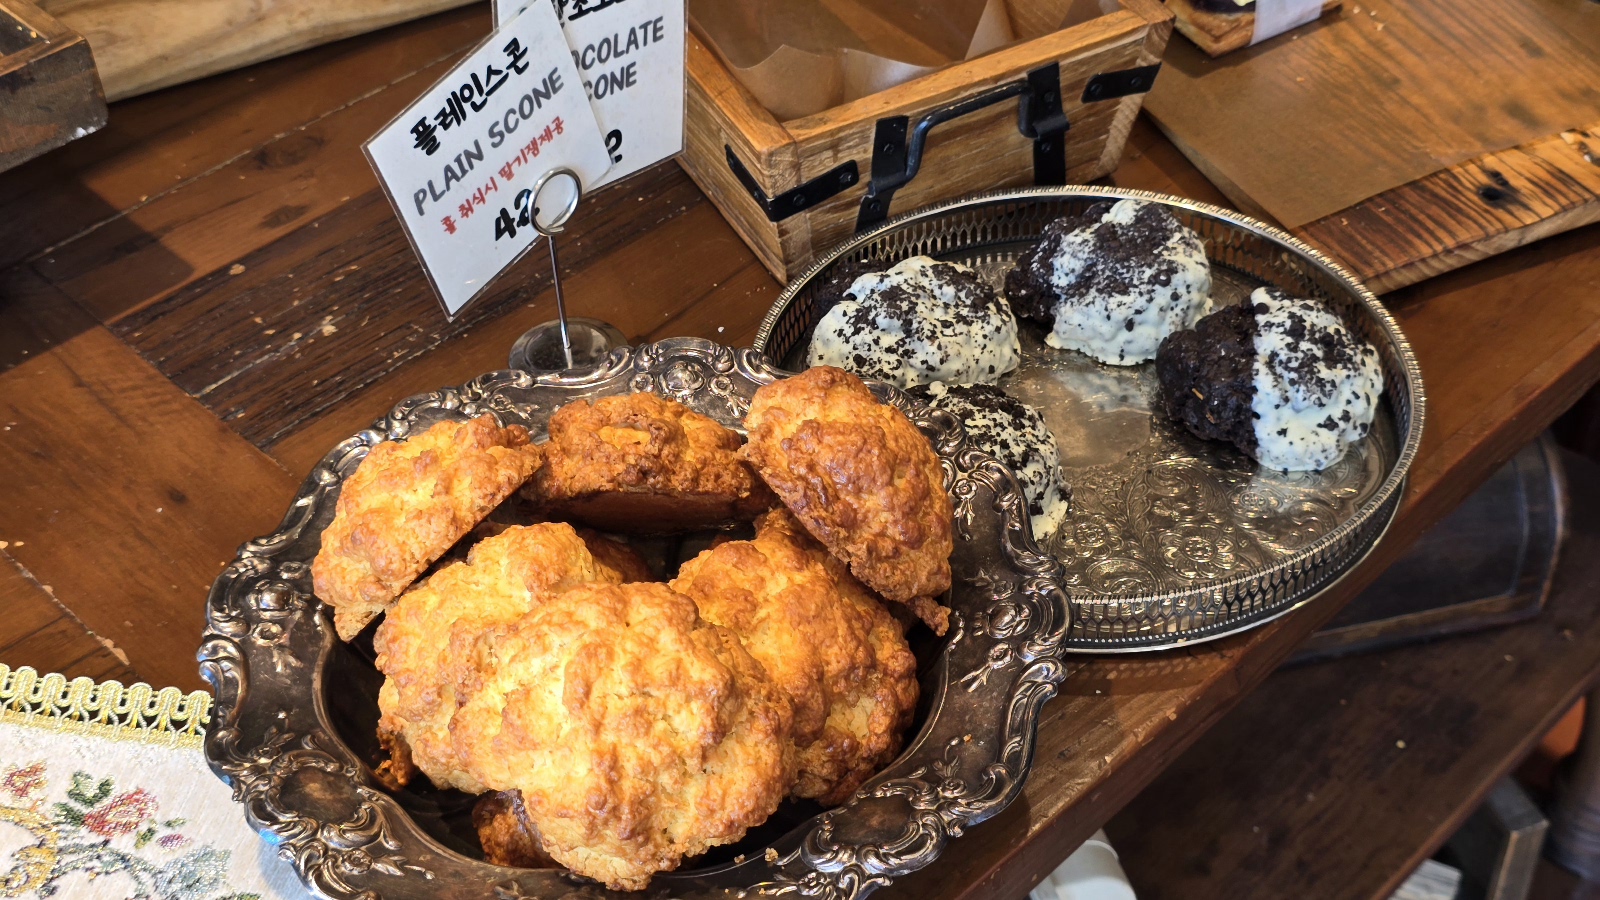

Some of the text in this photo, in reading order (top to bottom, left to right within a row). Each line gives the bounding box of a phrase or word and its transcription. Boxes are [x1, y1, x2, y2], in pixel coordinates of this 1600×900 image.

[410, 37, 530, 156] 플레인스콘
[413, 67, 565, 217] PLAIN SCONE
[458, 176, 499, 219] 취식시
[497, 115, 565, 181] 딸기잼제공
